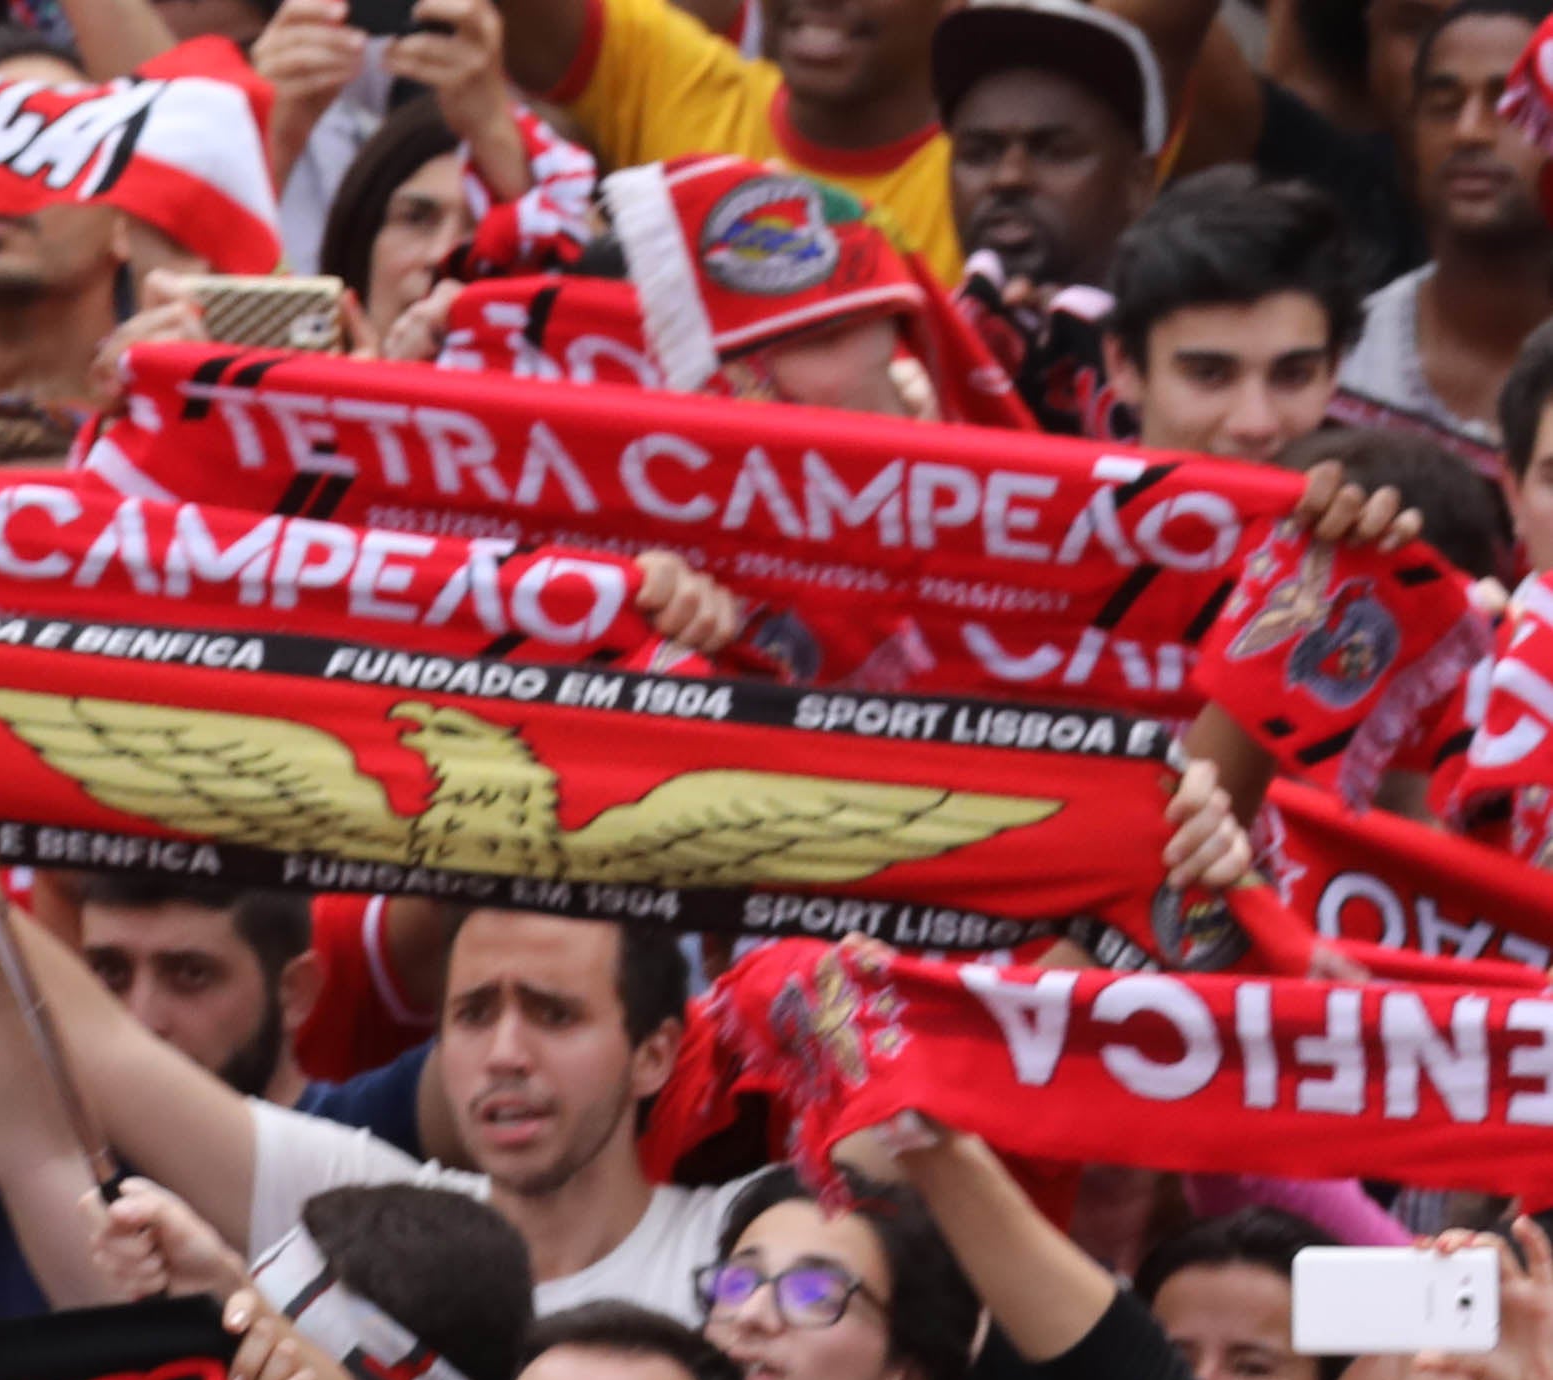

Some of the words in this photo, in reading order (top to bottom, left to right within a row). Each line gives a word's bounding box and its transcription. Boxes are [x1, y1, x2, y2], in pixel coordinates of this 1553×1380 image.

[180, 378, 600, 516] TETRA
[618, 455, 1240, 573] CAMPEÃO
[75, 623, 266, 672] BENFICA
[323, 645, 546, 700] FUNDADO
[554, 669, 622, 712] EM
[630, 676, 737, 720] 1904
[792, 691, 946, 743] SPORT
[951, 701, 1122, 753] LISBOA
